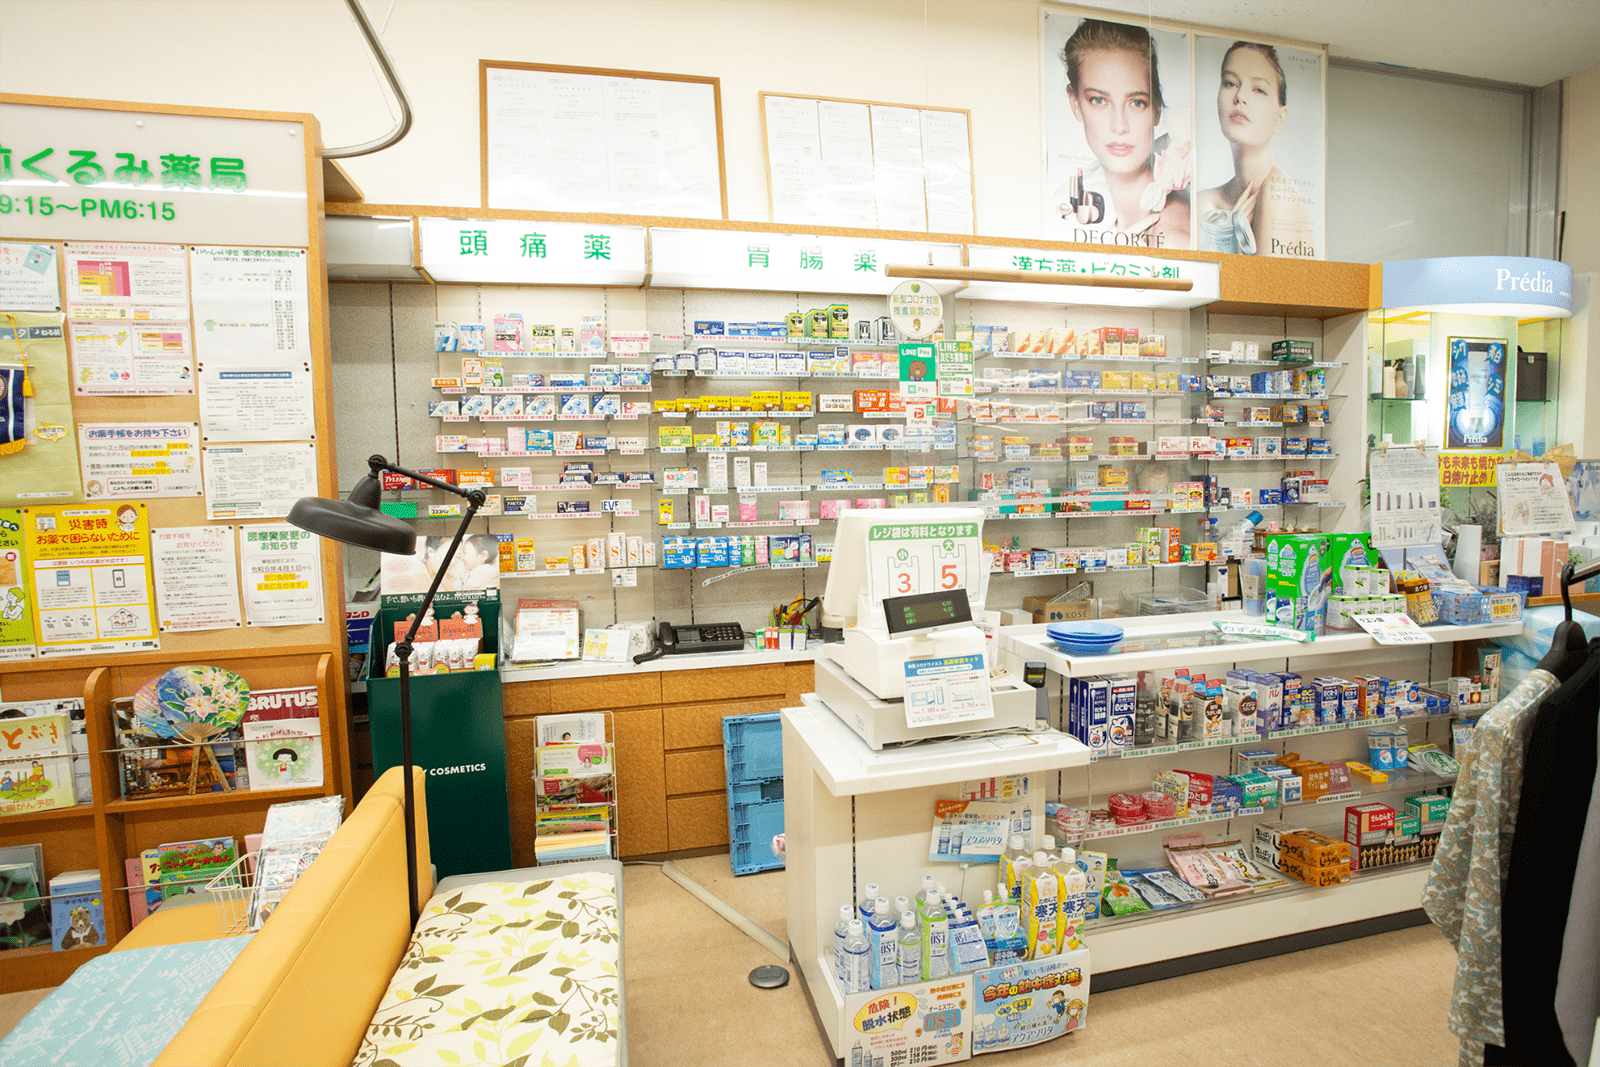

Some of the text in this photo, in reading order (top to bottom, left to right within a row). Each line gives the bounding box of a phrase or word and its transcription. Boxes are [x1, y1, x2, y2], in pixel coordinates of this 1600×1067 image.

[459, 230, 611, 260] 頭痛薬
[1073, 228, 1165, 248] DECORTÉ
[1270, 238, 1315, 257] Prédia
[747, 242, 877, 273] 胃腸薬
[1495, 268, 1553, 293] Prédia
[893, 306, 940, 316] 推進宣言の店
[939, 343, 957, 351] LINE
[88, 429, 187, 438] お薬手帳をお持ち下さい
[1463, 435, 1488, 444] Prédia
[1443, 470, 1494, 485] 日焼け止め！
[69, 519, 108, 531] 災害時
[873, 524, 974, 540] レジ袋は有料となります
[37, 532, 140, 545] お薬で困らないために
[247, 531, 311, 542] 医療費変更の
[261, 541, 298, 550] お知らせ
[944, 541, 954, 550] 大
[898, 550, 907, 559] 小
[898, 573, 911, 593] 3
[941, 564, 958, 589] 5
[1065, 610, 1088, 619] KOSÉ
[908, 661, 943, 670] 新型コロナウイルス
[247, 692, 318, 711] BRUTUS
[430, 763, 487, 776] COSMETICS
[966, 834, 1003, 847] アクアソリタ
[1034, 903, 1058, 917] 寒天
[1062, 899, 1086, 913] 寒天
[983, 968, 1082, 1002] 今年の熱中症対策
[868, 996, 898, 1015] 危険！
[928, 1002, 957, 1013] オーエスワン
[862, 1006, 912, 1031] 脱水状態
[924, 1011, 960, 1030] OS-1
[1012, 1026, 1054, 1044] アクアソリタ
